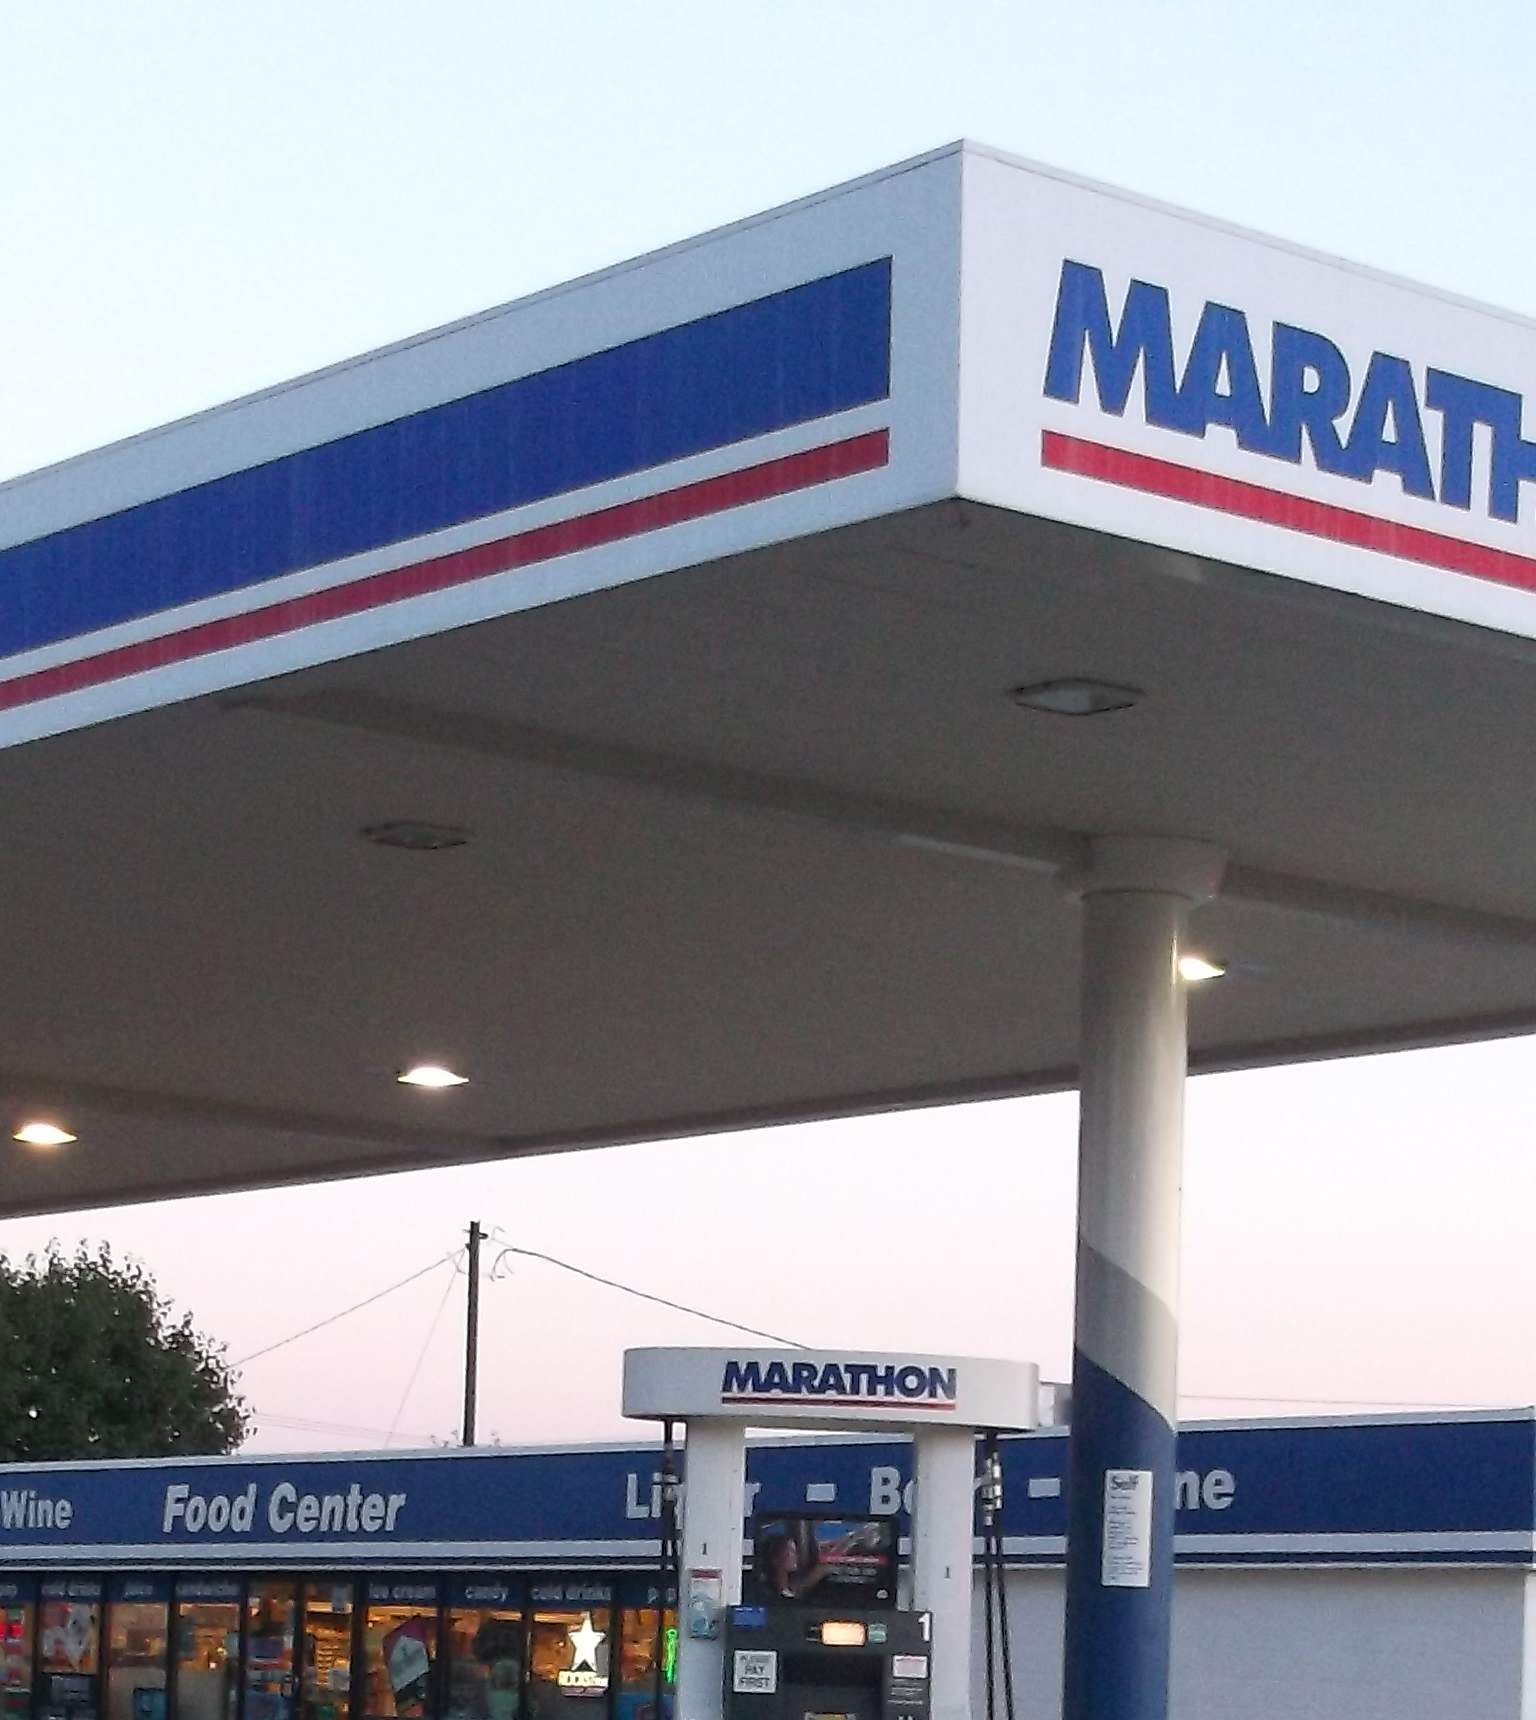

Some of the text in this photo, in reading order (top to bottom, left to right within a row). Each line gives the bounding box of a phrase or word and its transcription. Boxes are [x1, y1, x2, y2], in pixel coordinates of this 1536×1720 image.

[721, 1361, 957, 1399] MARATHON
[0, 1490, 73, 1530] Wine
[162, 1482, 407, 1533] Food Center
[917, 1612, 931, 1642] 1
